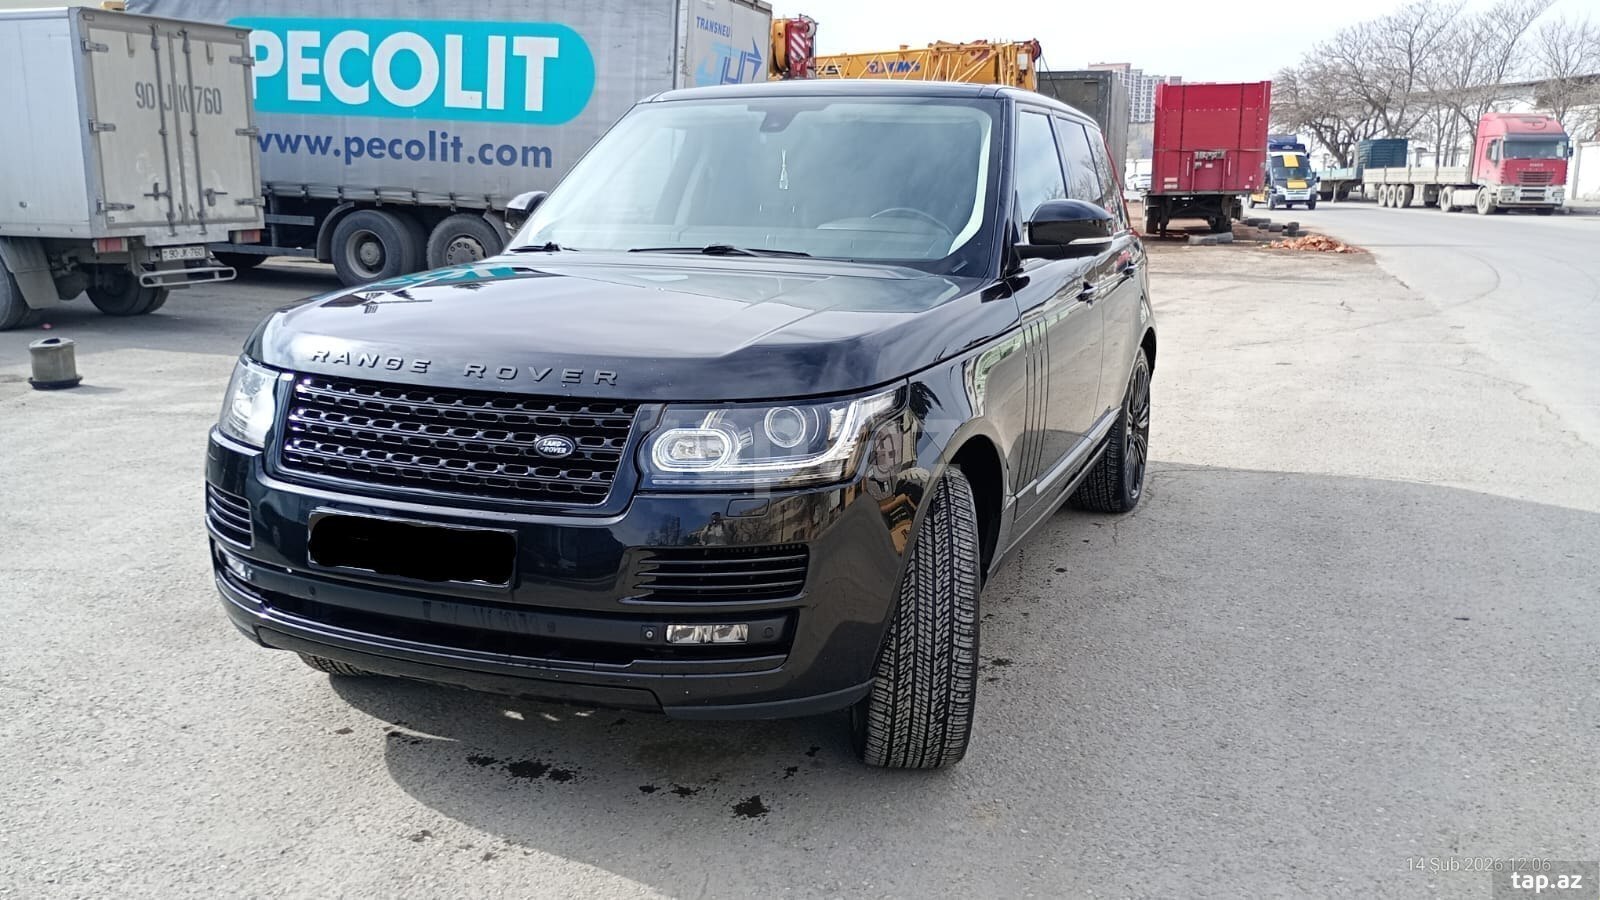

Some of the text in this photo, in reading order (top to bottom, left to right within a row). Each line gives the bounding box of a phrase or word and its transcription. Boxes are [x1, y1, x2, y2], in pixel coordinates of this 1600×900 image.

[248, 30, 559, 112] PECOLIT
[135, 81, 156, 110] 90
[193, 86, 222, 115] 760
[310, 350, 618, 386] RANGE ROVER
